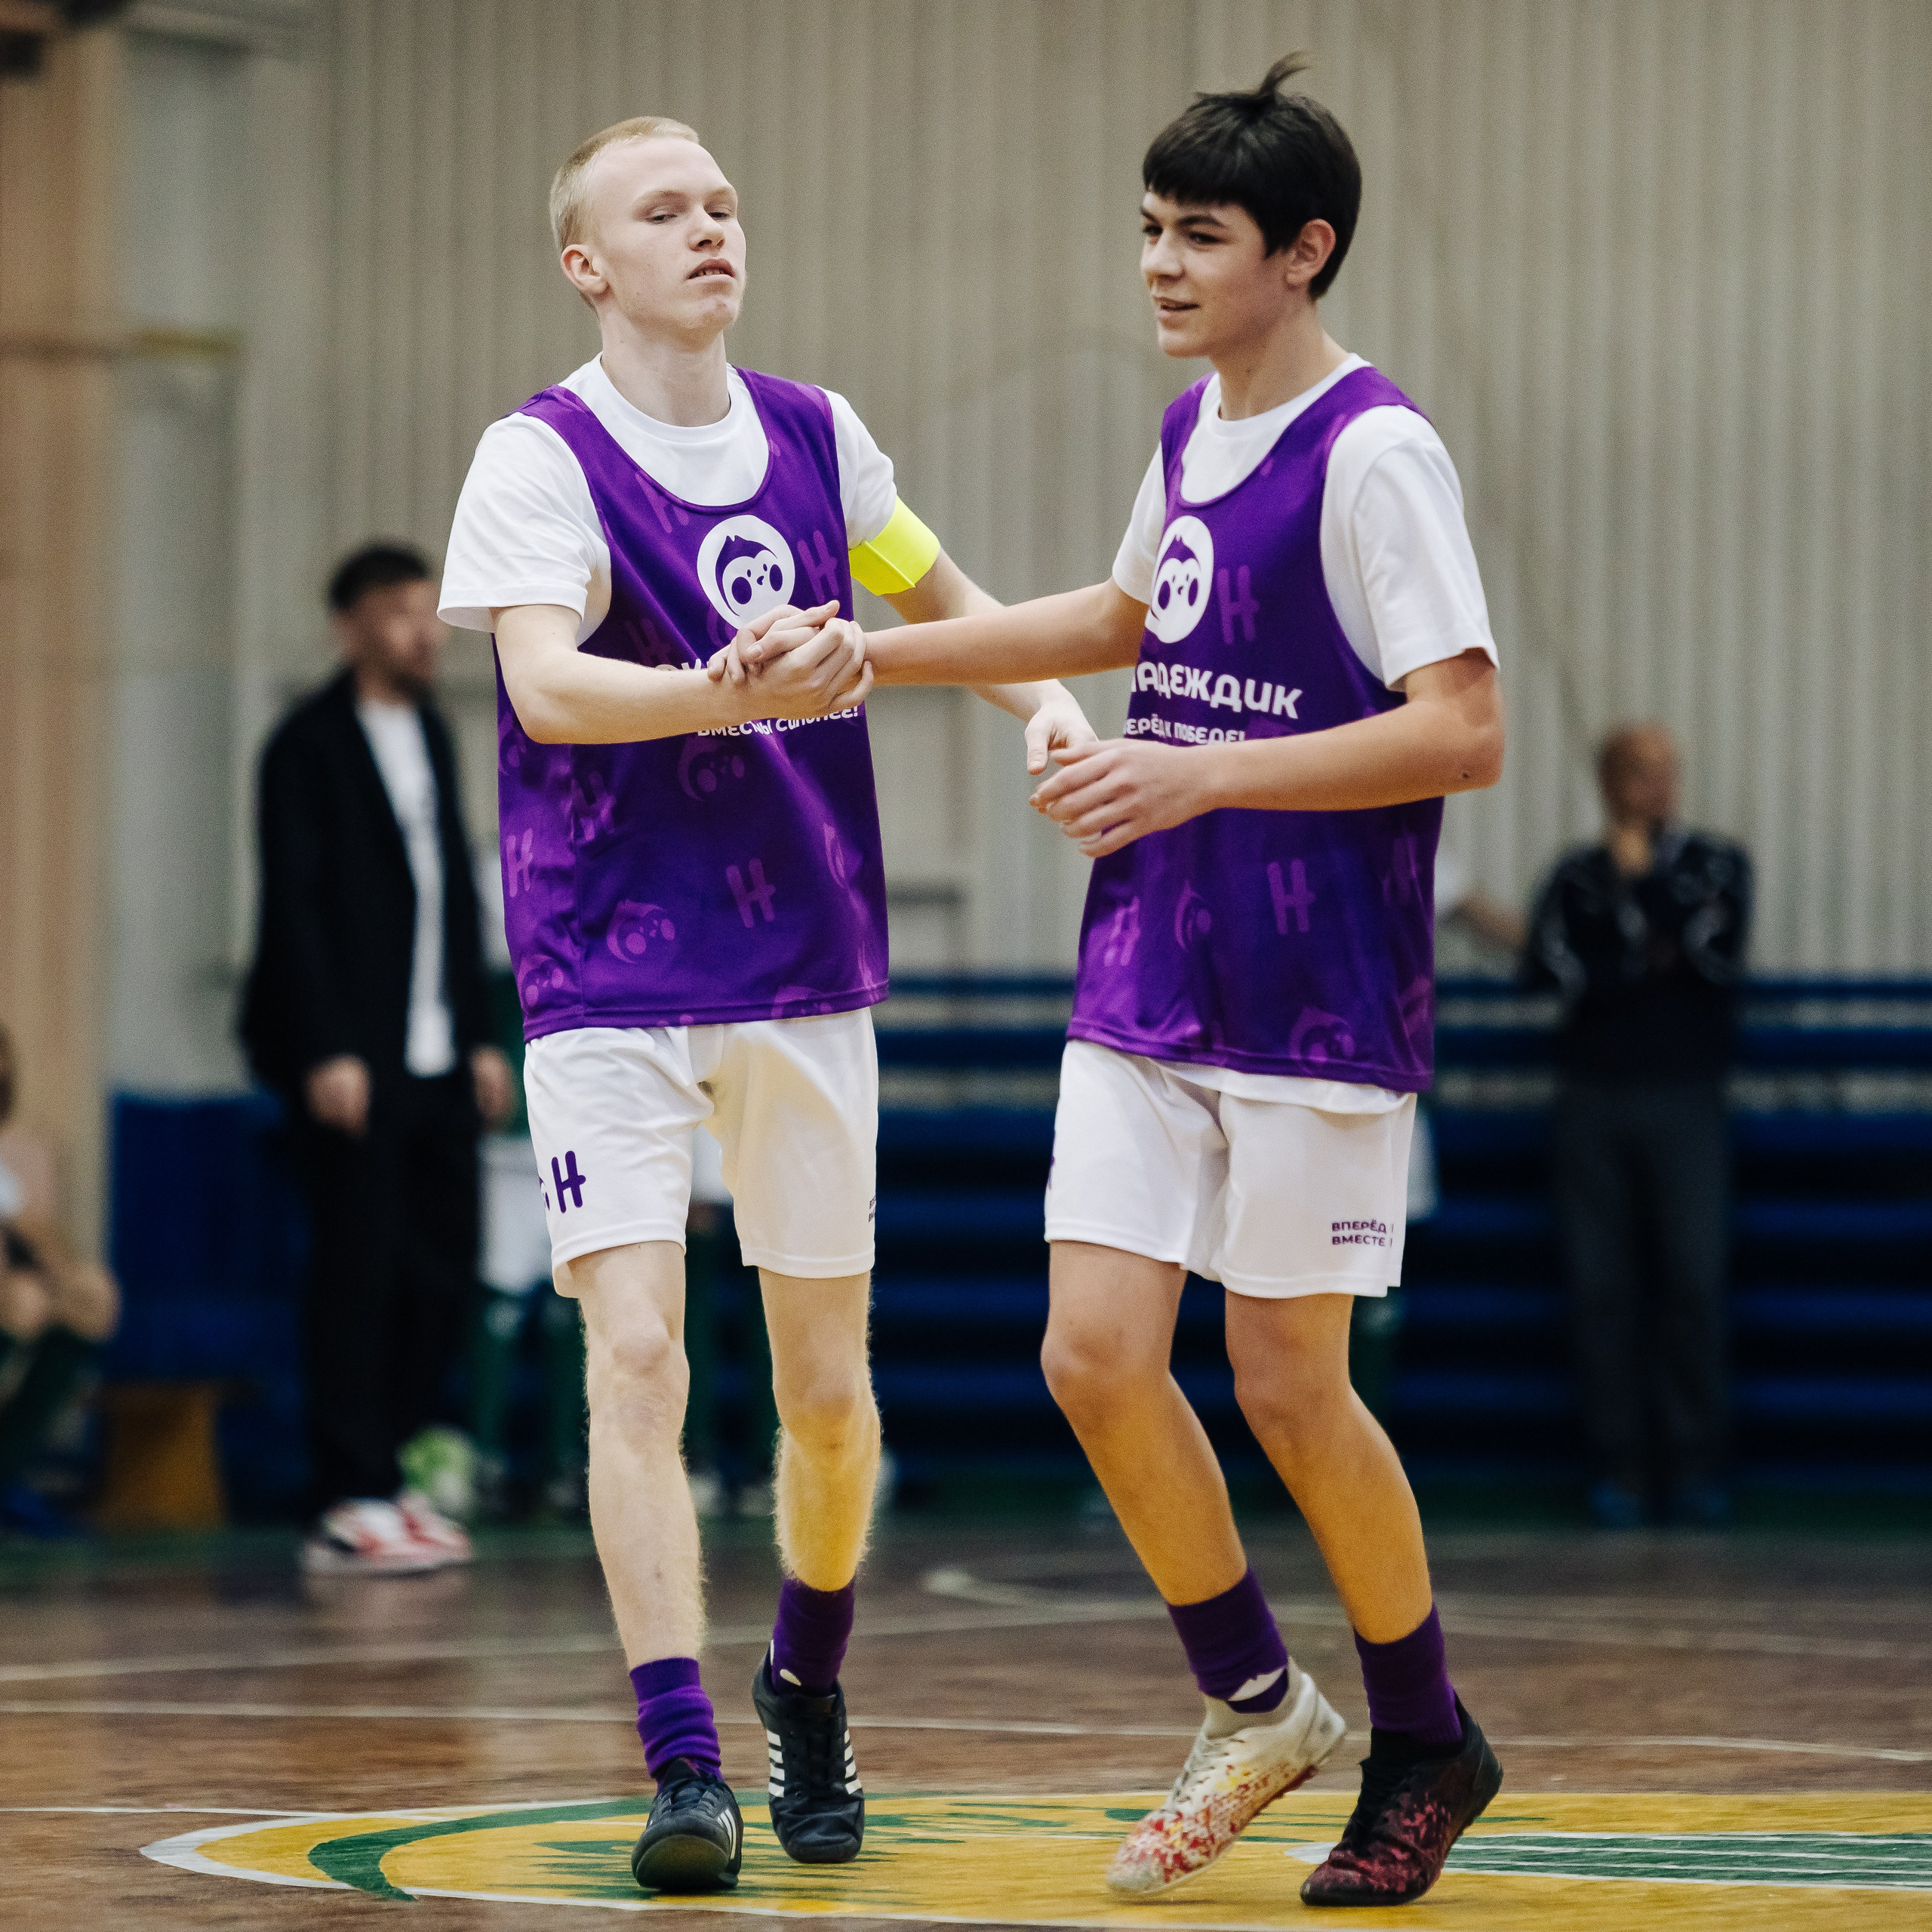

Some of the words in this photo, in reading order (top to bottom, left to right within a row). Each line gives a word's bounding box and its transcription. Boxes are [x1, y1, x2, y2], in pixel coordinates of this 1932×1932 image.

[551, 1151, 586, 1214] Н
[1331, 1219, 1387, 1234] ВПЕРЁД
[1331, 1235, 1386, 1247] ВМЕСТЕ
